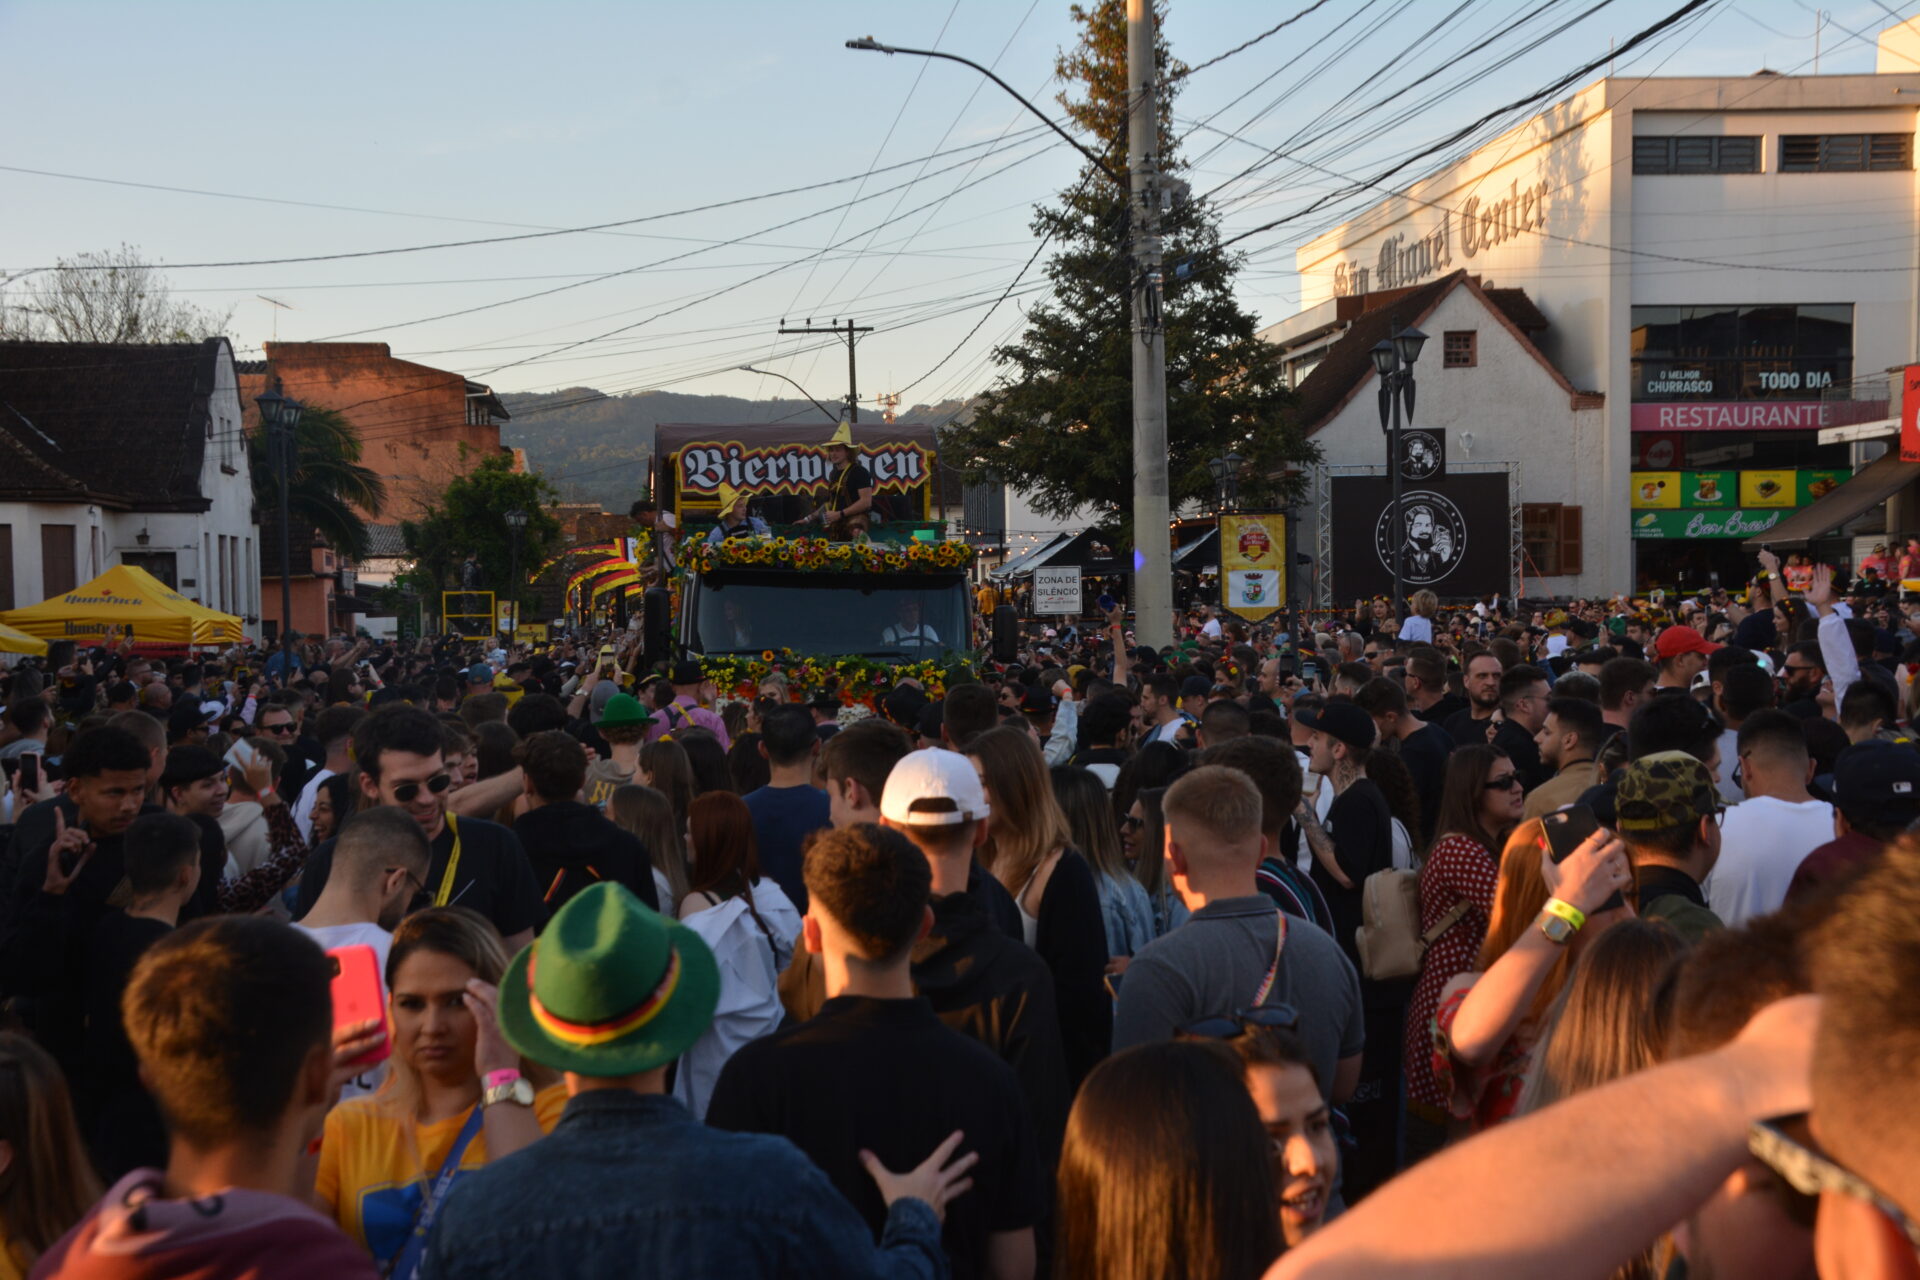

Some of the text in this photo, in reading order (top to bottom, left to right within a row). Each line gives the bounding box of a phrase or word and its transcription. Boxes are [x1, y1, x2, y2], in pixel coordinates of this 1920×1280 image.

[1376, 210, 1452, 290] Miguel
[1461, 178, 1548, 258] Center
[1668, 370, 1700, 379] MELHOR
[1759, 371, 1832, 389] TODO DIA
[1647, 380, 1713, 393] CHURRASCO
[1660, 405, 1830, 428] RESTAURANTE
[1685, 511, 1779, 538] Bar Brasil
[1038, 576, 1078, 584] ZONA DE
[1037, 586, 1079, 596] SILÊNCIO
